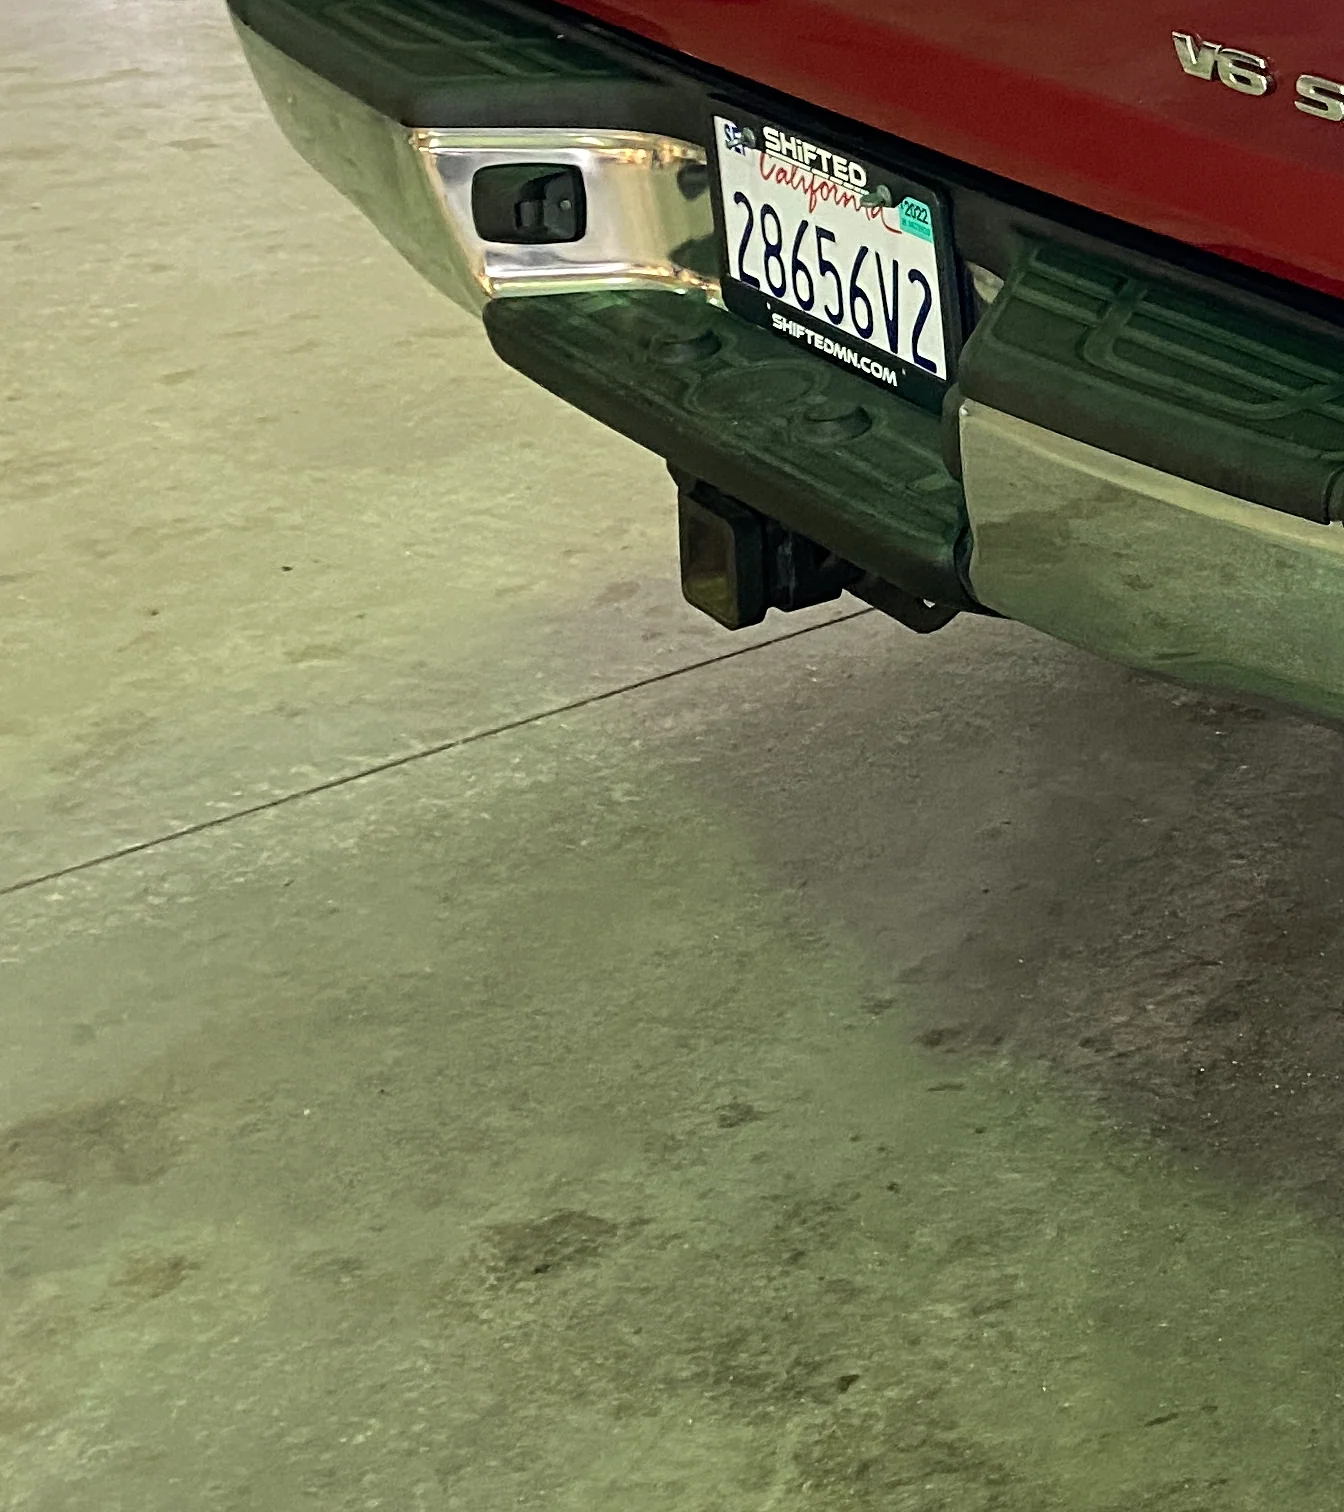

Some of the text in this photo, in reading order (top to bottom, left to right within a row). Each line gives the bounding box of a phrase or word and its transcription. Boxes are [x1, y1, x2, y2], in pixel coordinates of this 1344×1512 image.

[1171, 31, 1269, 96] V6
[733, 190, 938, 374] 28656V2
[771, 312, 898, 387] SHIFTEDMN.COM
